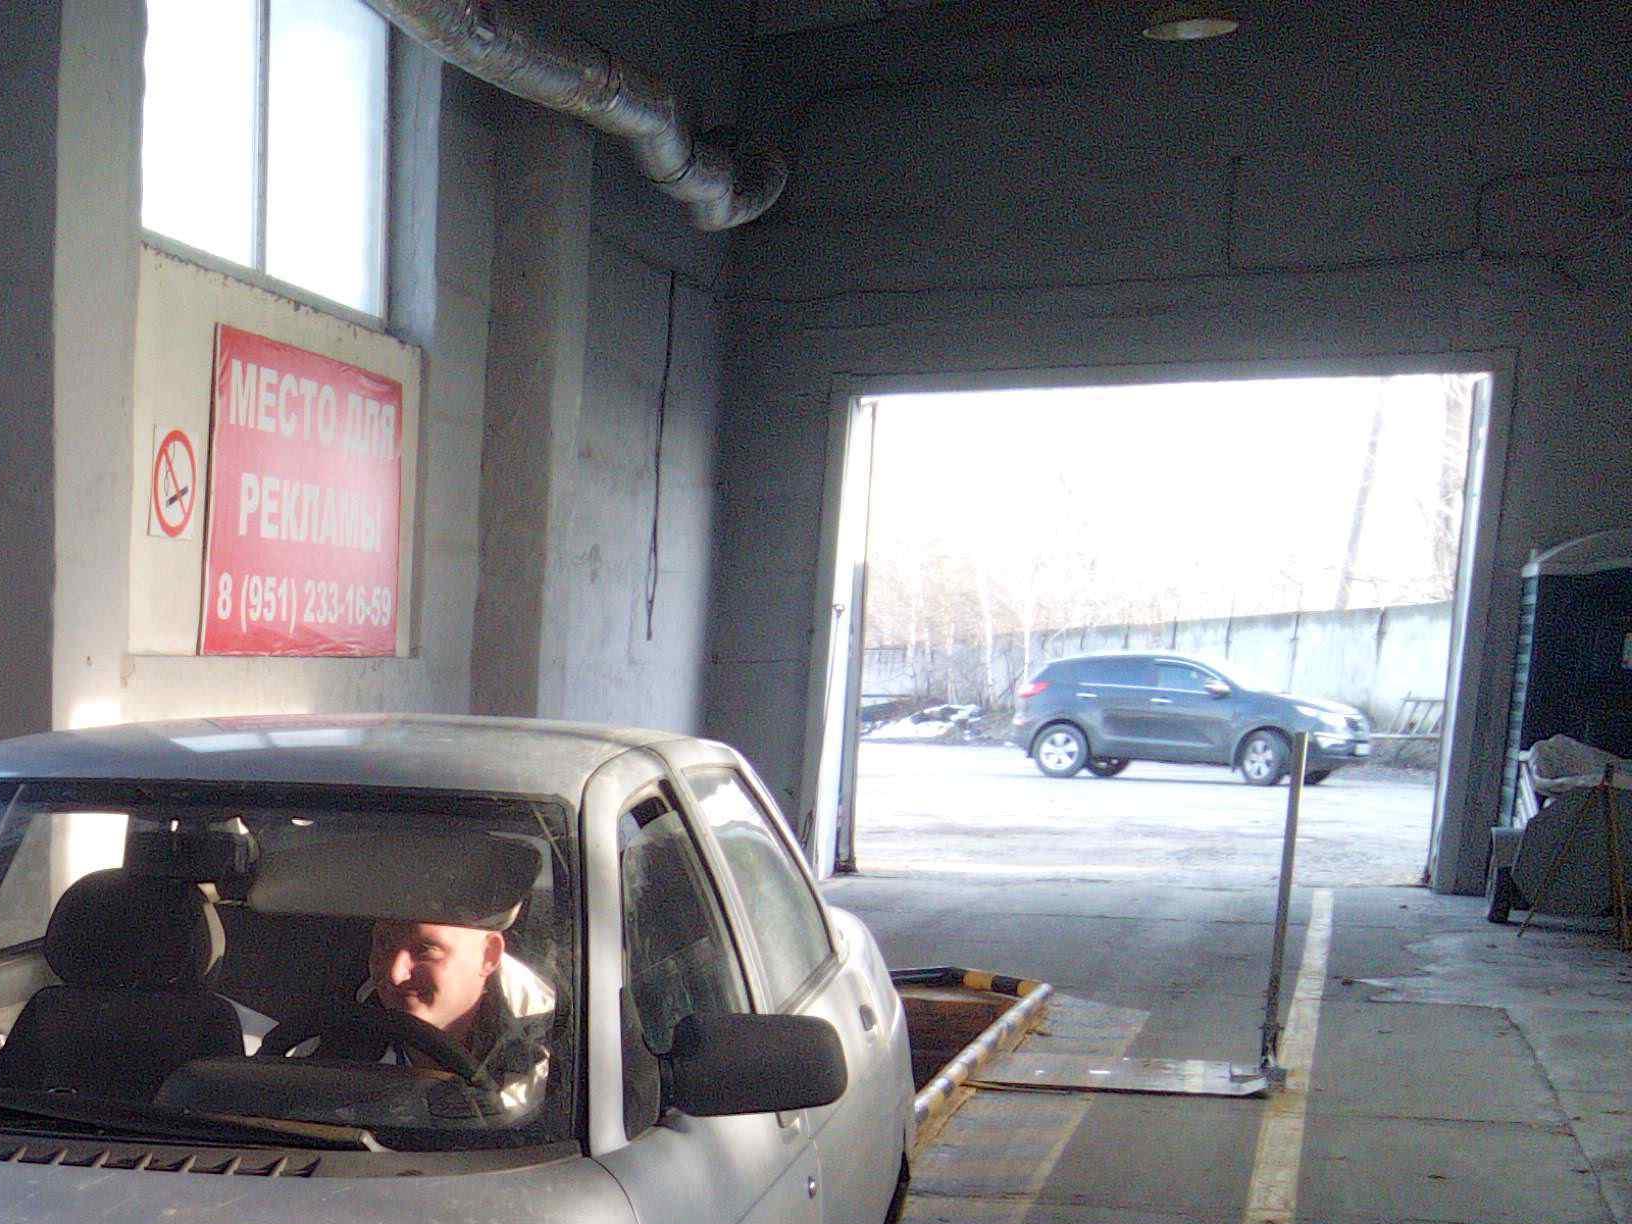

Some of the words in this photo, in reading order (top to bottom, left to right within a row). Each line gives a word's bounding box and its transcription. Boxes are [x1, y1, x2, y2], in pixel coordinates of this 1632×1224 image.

[229, 357, 337, 447] МЕСТО
[343, 393, 396, 460] ДЛЯ
[238, 472, 384, 552] РЕКЛАМЫ
[217, 571, 233, 620] 8
[240, 574, 298, 634] (951)
